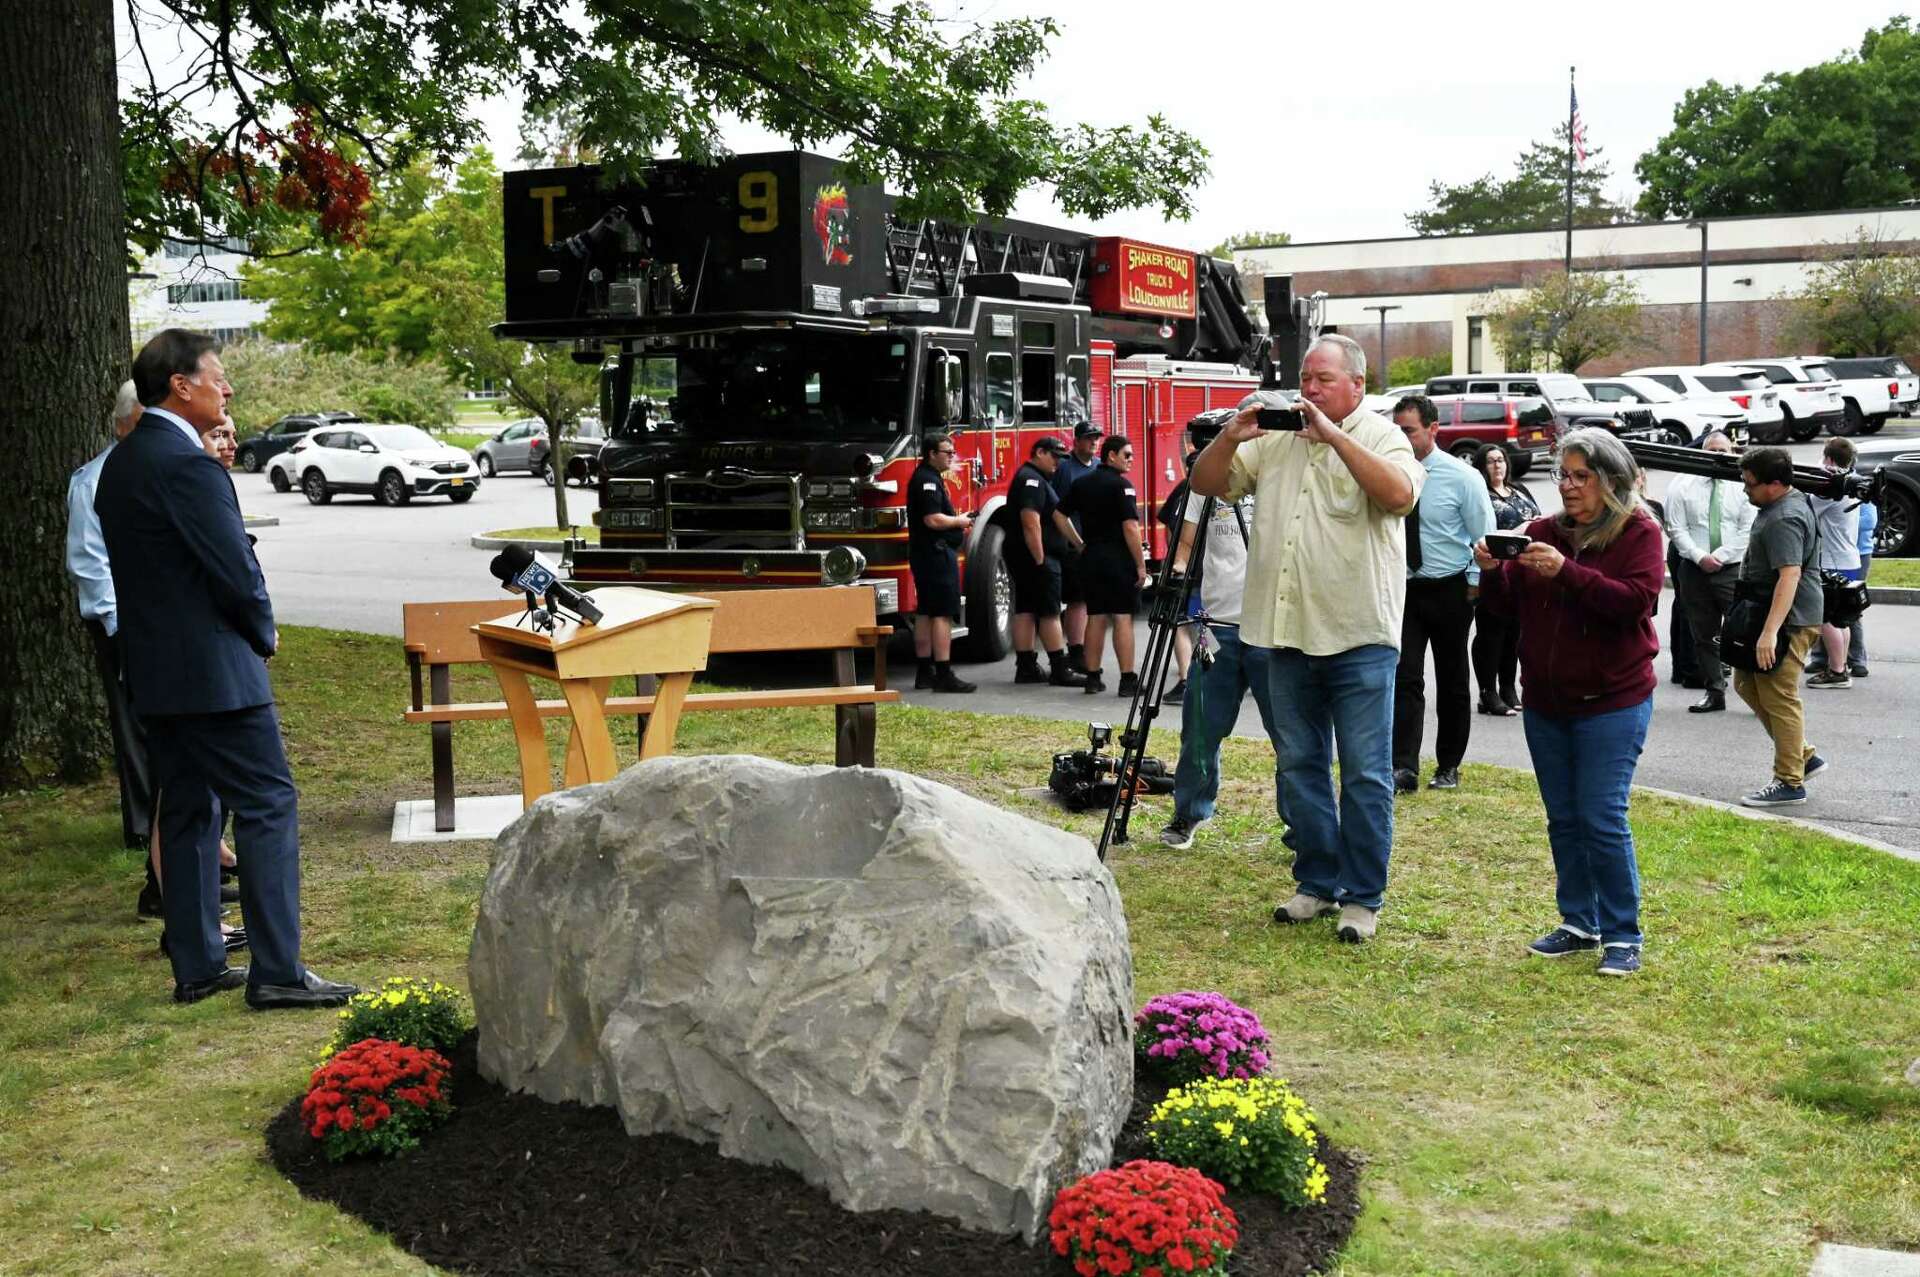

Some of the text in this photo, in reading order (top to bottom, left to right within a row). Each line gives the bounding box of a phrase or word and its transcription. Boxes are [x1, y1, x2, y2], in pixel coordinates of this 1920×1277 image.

[738, 171, 778, 233] 9
[529, 186, 567, 246] T
[1128, 248, 1188, 280] SHAKER ROAD
[1146, 272, 1167, 289] TRUCK
[1129, 281, 1188, 309] LOUDONVILLE
[994, 438, 1011, 448] RUCK
[519, 564, 541, 586] NEWS
[528, 569, 552, 592] 10
